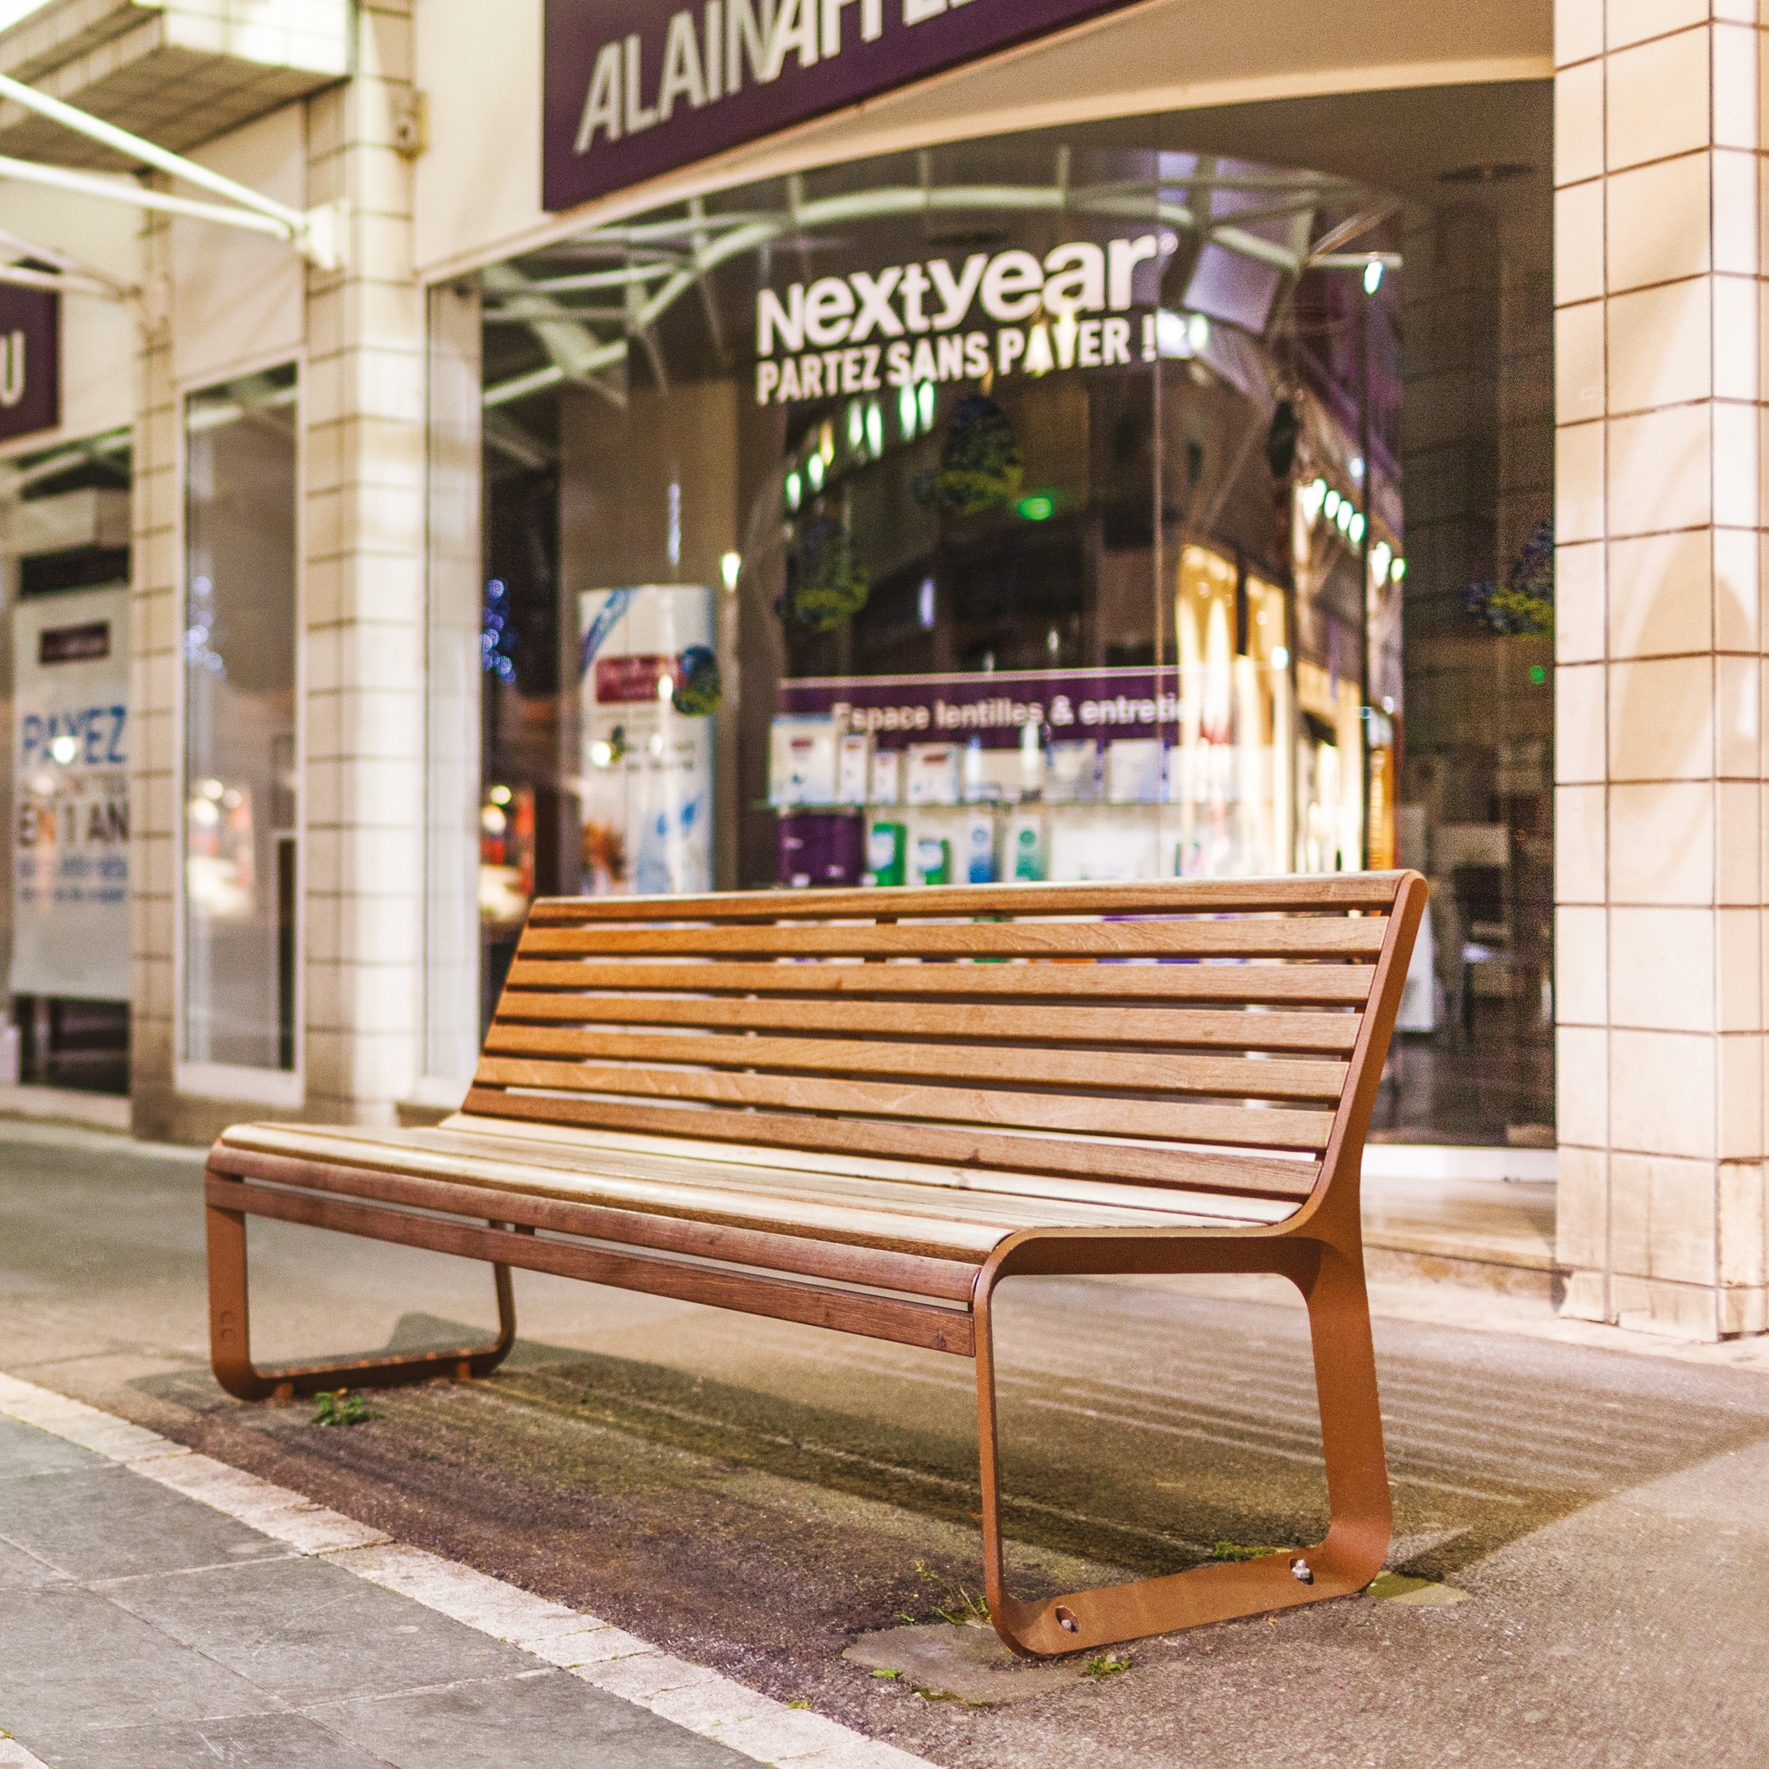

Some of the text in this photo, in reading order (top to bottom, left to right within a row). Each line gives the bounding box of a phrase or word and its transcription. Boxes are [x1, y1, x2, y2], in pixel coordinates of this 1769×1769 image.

[757, 233, 1157, 356] Nextyear
[757, 345, 880, 405] PARTEZ
[887, 331, 989, 385] SANS
[999, 315, 1131, 375] PAYER
[832, 702, 930, 739] Espace
[935, 698, 1044, 728] lentilles
[1052, 695, 1074, 727] &
